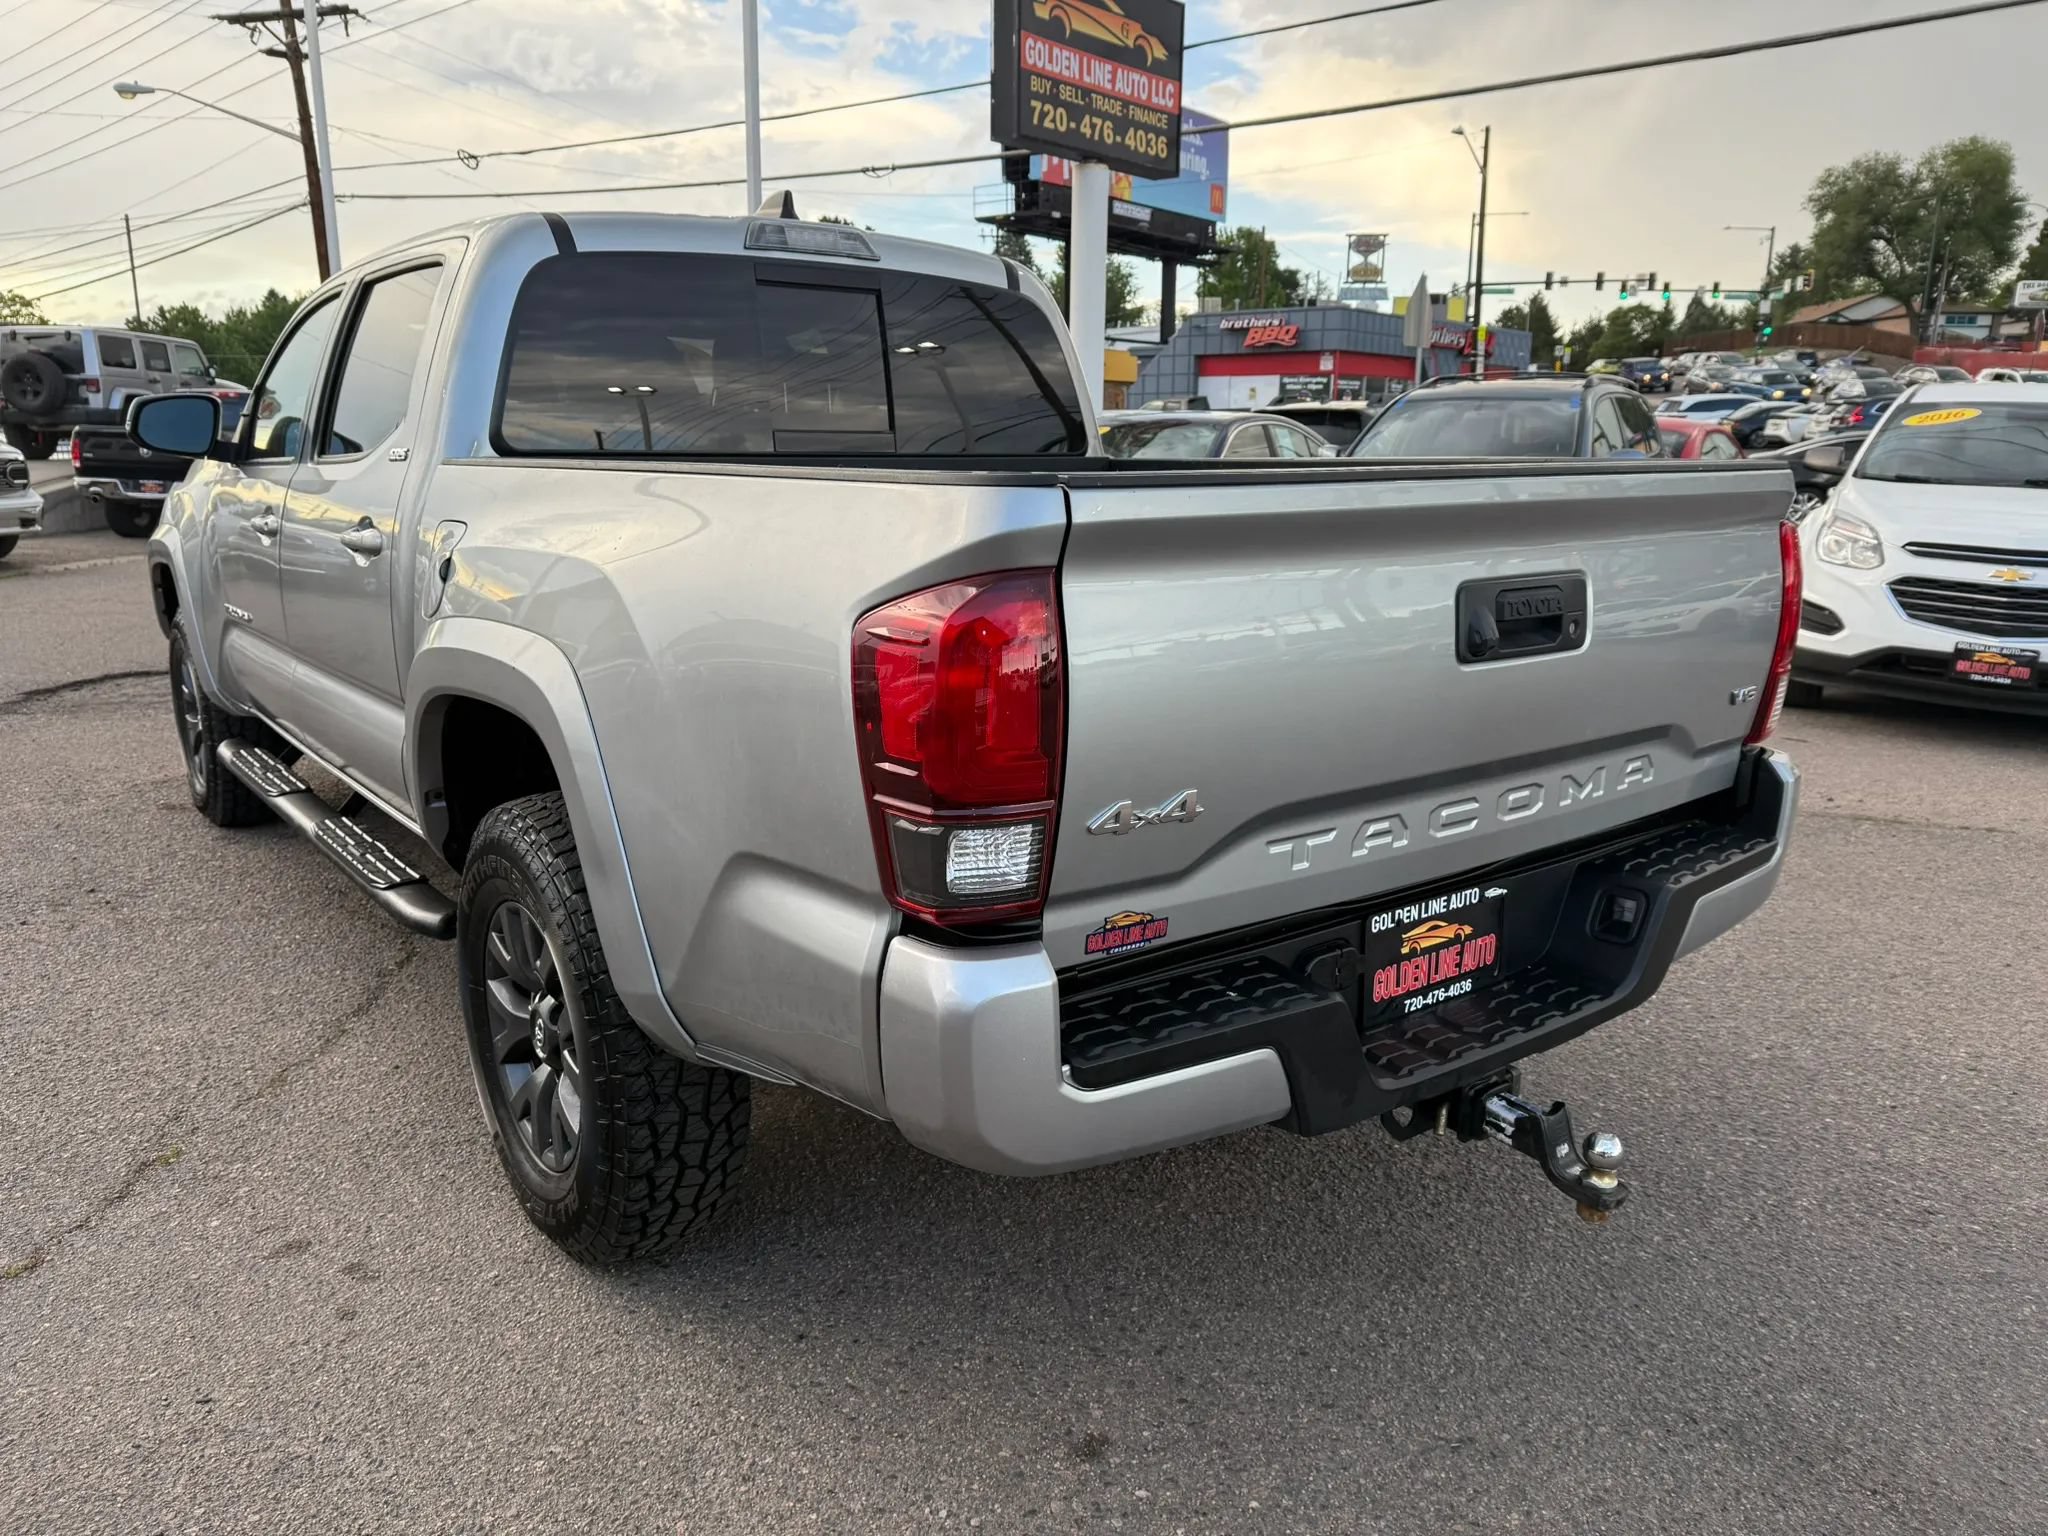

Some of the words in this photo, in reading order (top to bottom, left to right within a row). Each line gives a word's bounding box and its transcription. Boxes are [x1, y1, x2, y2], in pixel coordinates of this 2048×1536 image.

[1025, 37, 1080, 80] GOLDEN
[1083, 55, 1113, 89] LINE
[1115, 67, 1148, 100] AUTO
[1151, 78, 1175, 108] LLC
[1030, 75, 1052, 96] BUY
[1059, 84, 1084, 105] SELL
[1091, 93, 1123, 116] TRADE
[1128, 106, 1169, 129] FINANCE
[1219, 317, 1280, 329] brothers
[1243, 325, 1298, 347] BBQ
[1917, 410, 1966, 424] 2016
[1507, 596, 1563, 617] TOYOTA
[2002, 646, 2021, 655] AUTO
[1956, 659, 1989, 674] GOLDEN
[1989, 663, 2009, 676] LINE
[2007, 665, 2032, 680] AUTO
[1086, 788, 1205, 836] 4x4
[1265, 753, 1655, 871] TACOMA
[1371, 904, 1419, 933] GOLDEN
[1421, 896, 1448, 918] LINE
[1449, 887, 1480, 910] AUTO
[1087, 929, 1123, 952] GOLDEN
[1123, 924, 1145, 945] LINE
[1144, 919, 1168, 940] AUTO
[1109, 942, 1145, 954] COLORADO
[1373, 954, 1429, 1003] GOLDEN
[1430, 944, 1461, 985] LINE
[1461, 933, 1496, 974] AUTO
[1404, 978, 1472, 1014] 720-476-4036
